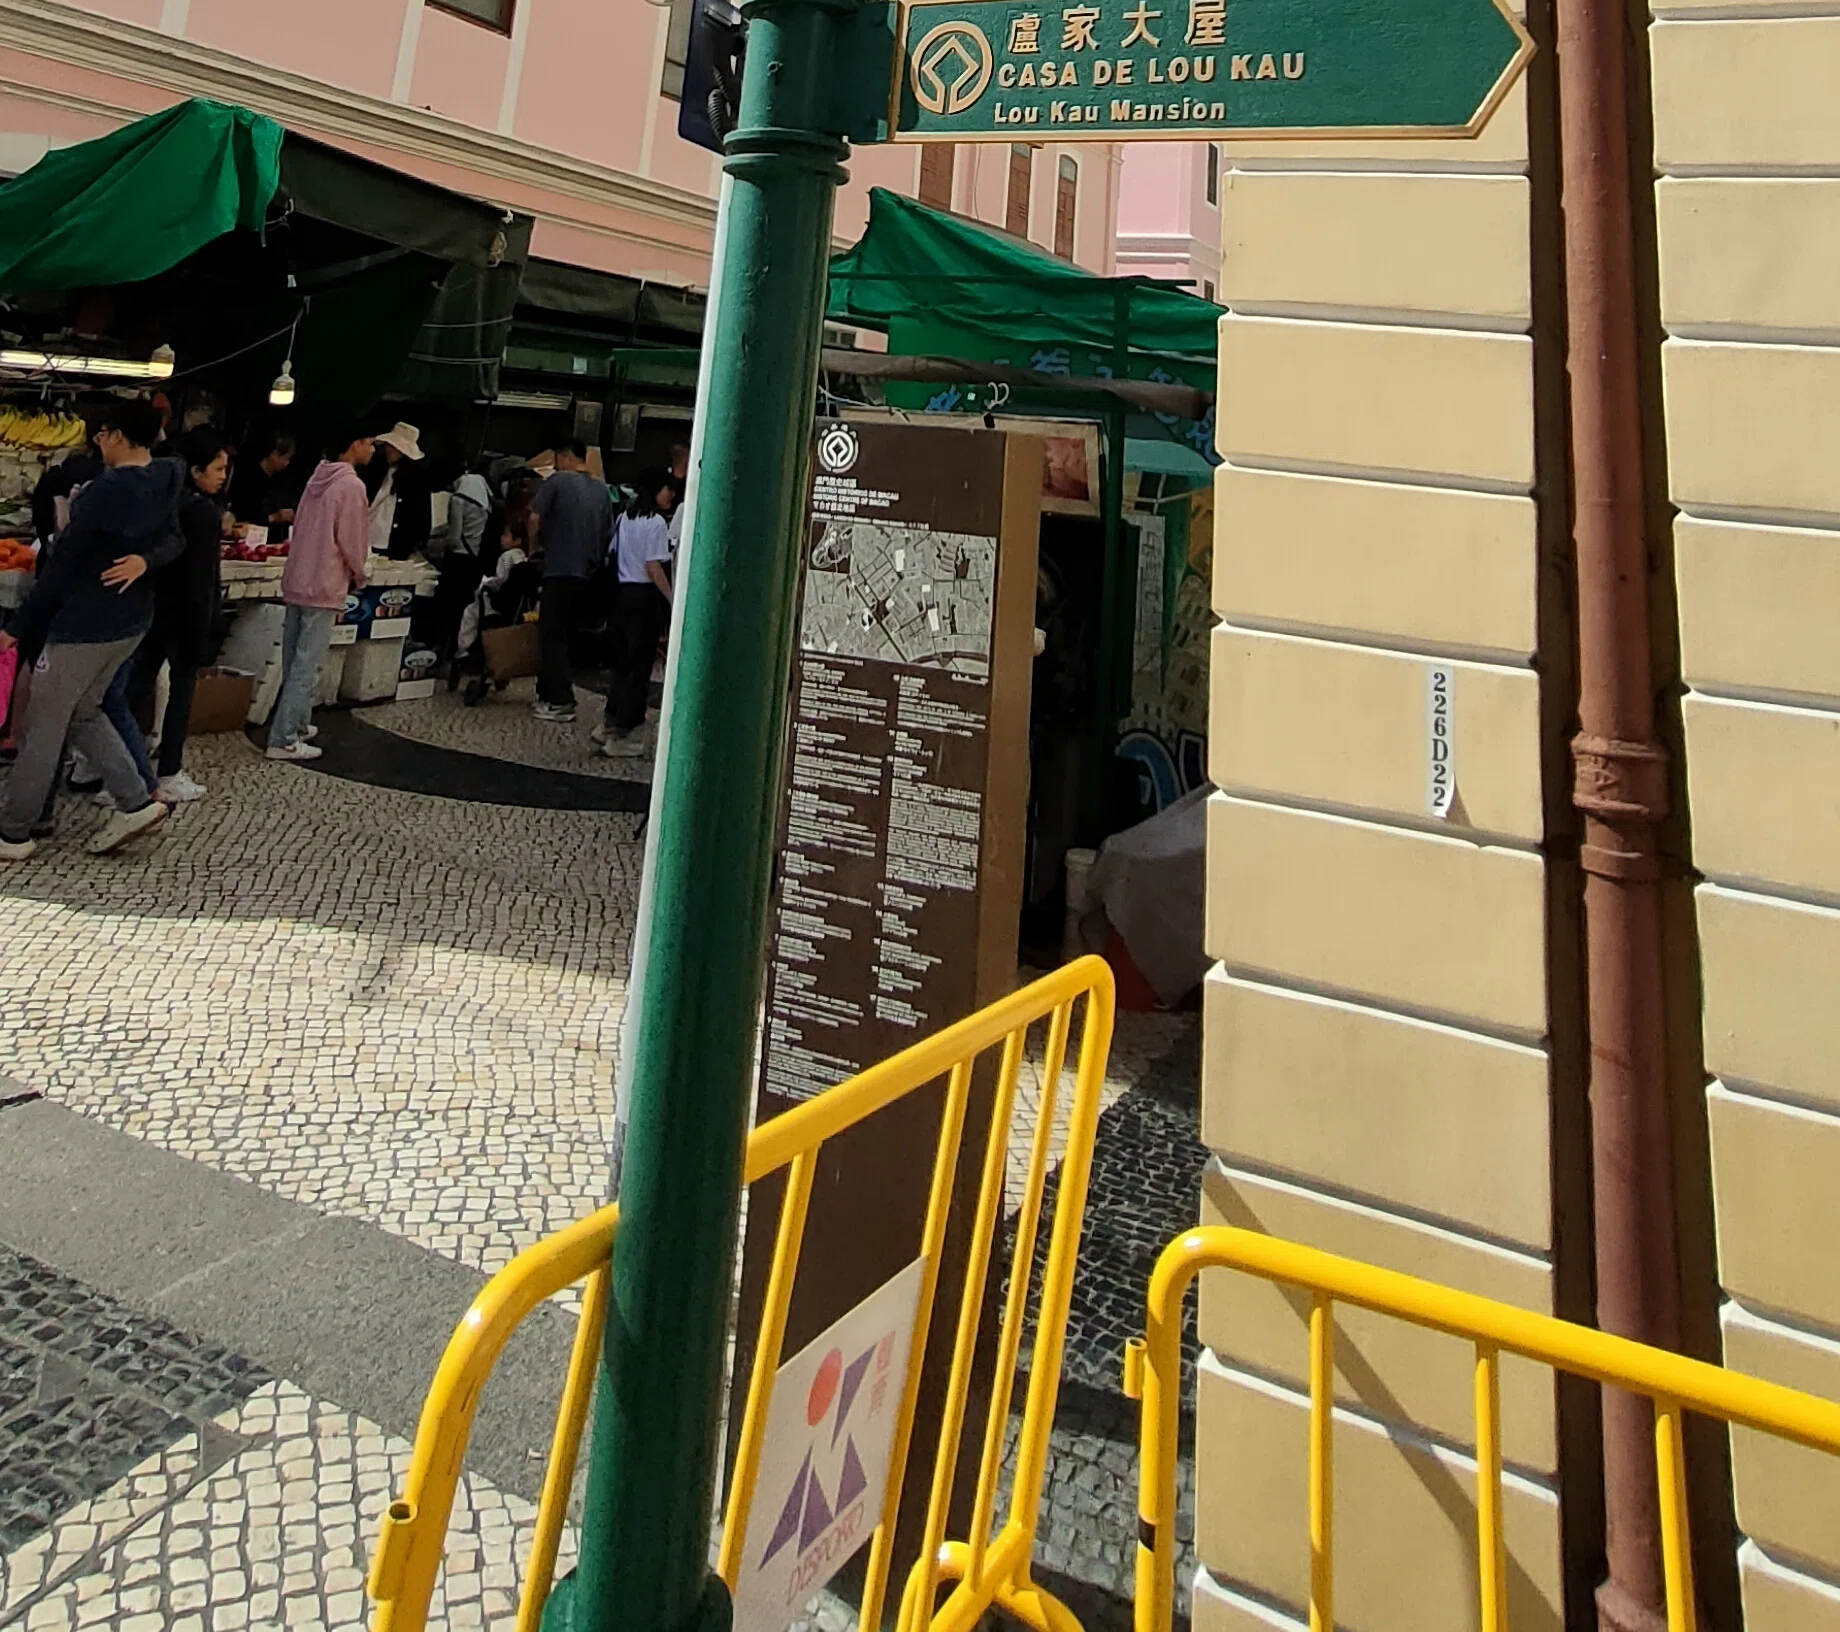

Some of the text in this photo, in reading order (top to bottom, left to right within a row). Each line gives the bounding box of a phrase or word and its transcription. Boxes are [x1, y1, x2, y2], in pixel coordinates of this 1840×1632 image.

[998, 52, 1305, 88] CASA DE LOU KAU
[994, 96, 1226, 124] Lou Kau Mansion
